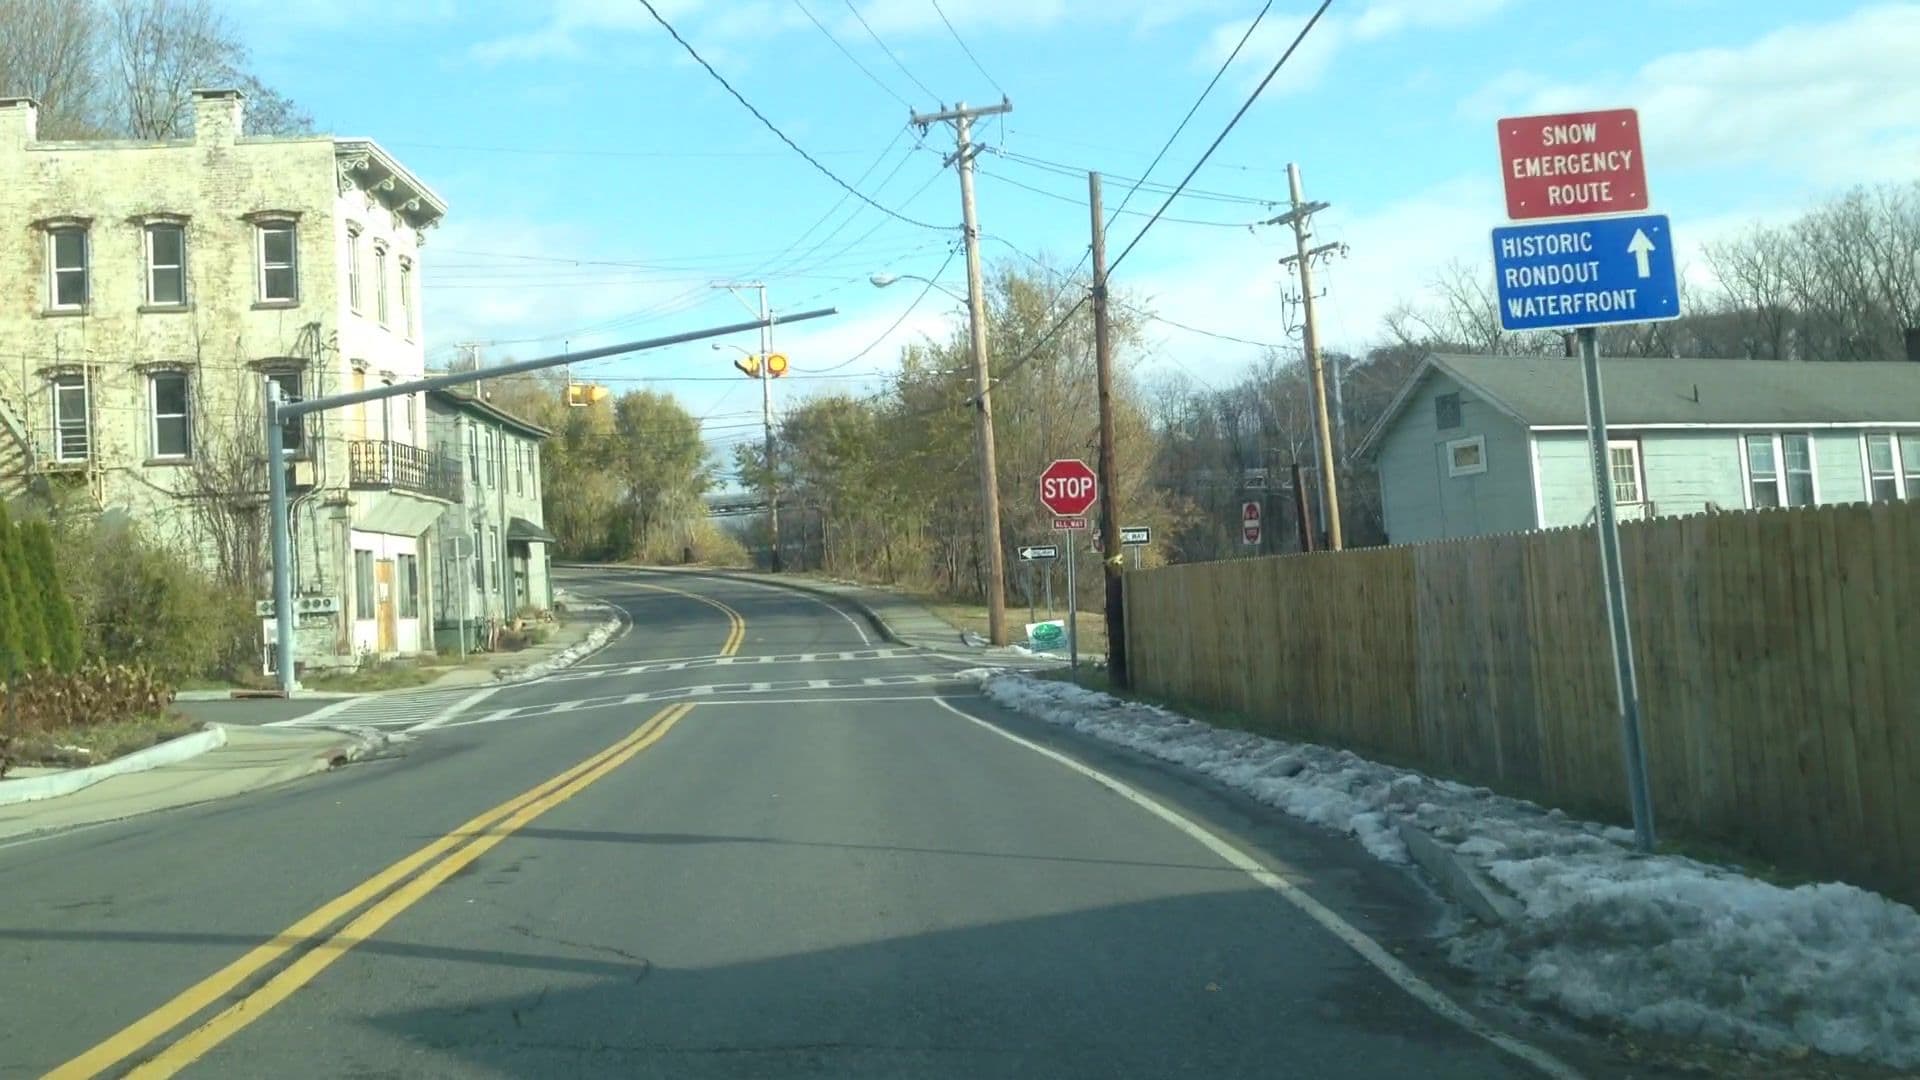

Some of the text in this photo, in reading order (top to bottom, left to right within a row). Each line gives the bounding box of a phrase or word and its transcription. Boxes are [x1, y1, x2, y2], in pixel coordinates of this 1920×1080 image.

[1542, 123, 1596, 146] SNOW
[1512, 150, 1632, 178] EMERGENCY
[1548, 182, 1612, 205] ROUTE
[1502, 232, 1593, 258] HISTORIC
[1505, 262, 1600, 288] RONDOUT
[1508, 289, 1637, 318] WATERFRONT
[1045, 477, 1092, 499] STOP
